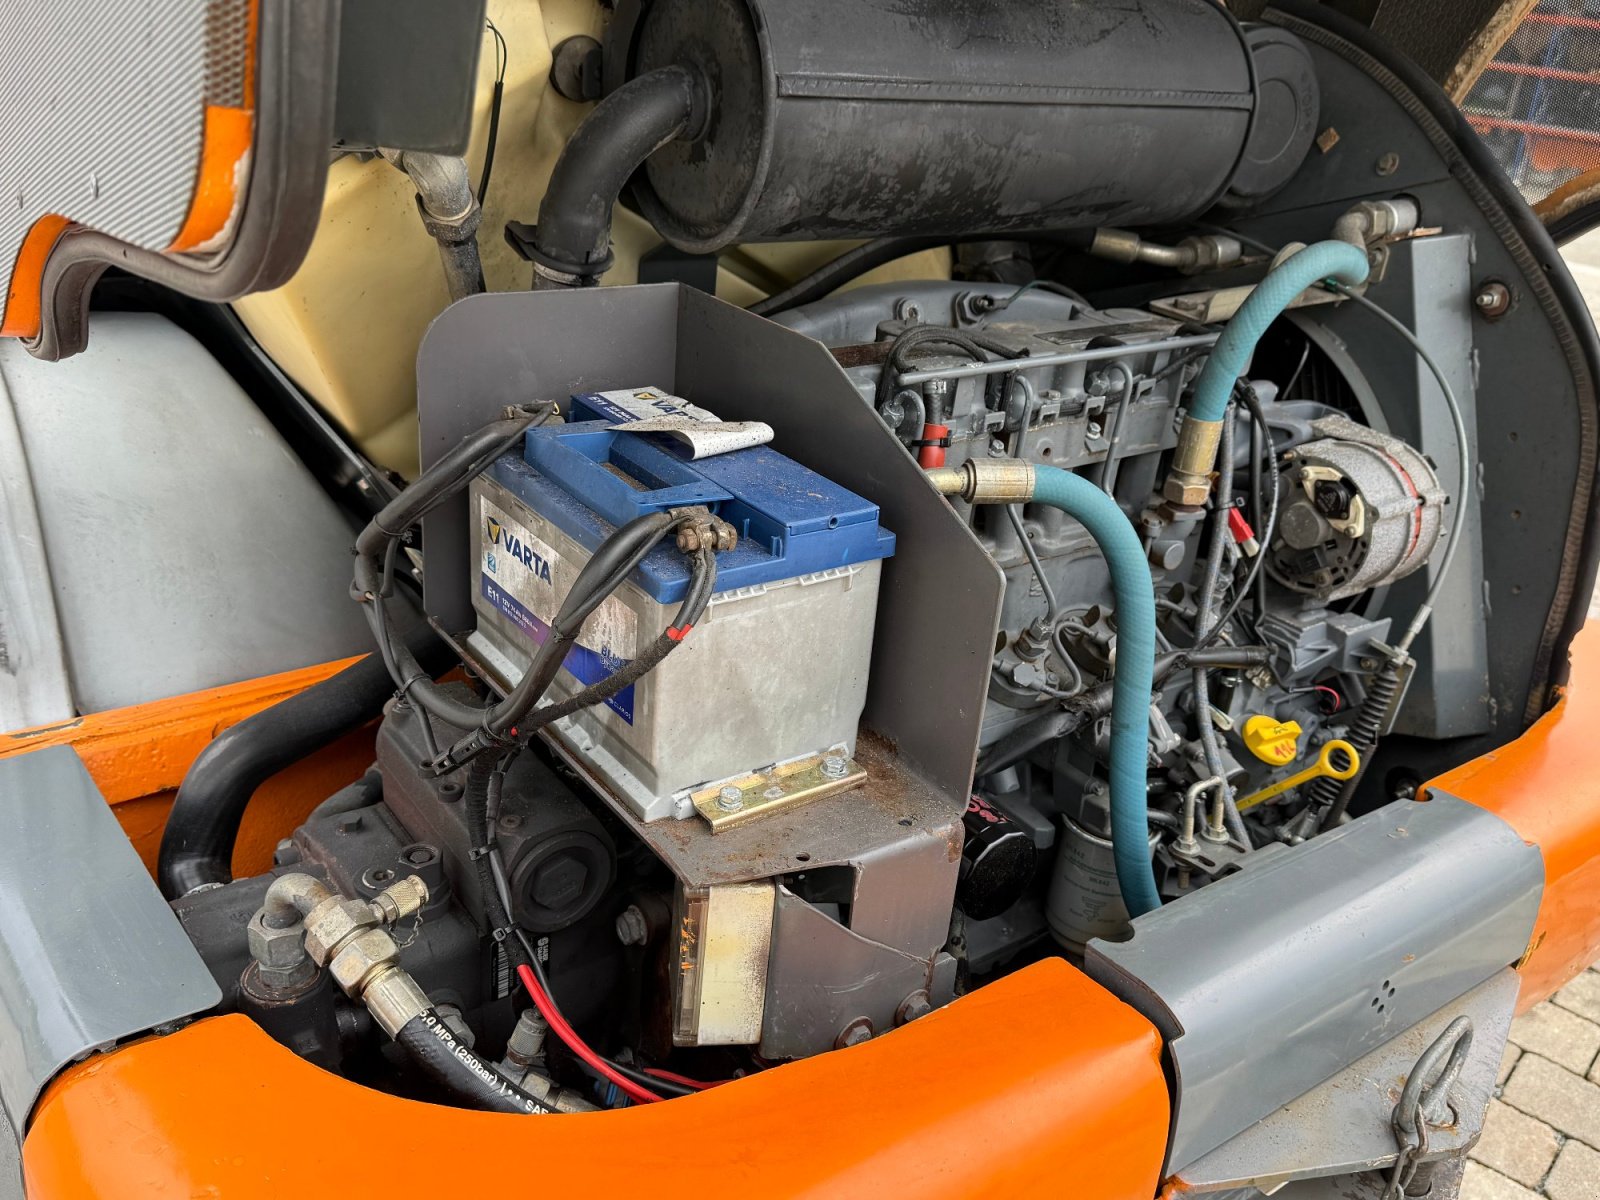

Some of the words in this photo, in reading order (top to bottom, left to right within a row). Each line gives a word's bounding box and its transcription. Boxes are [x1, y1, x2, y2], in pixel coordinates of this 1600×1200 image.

[503, 528, 552, 586] VARTA
[487, 585, 500, 604] E11
[431, 1023, 457, 1050] MPa
[454, 1045, 498, 1087] (250bar)
